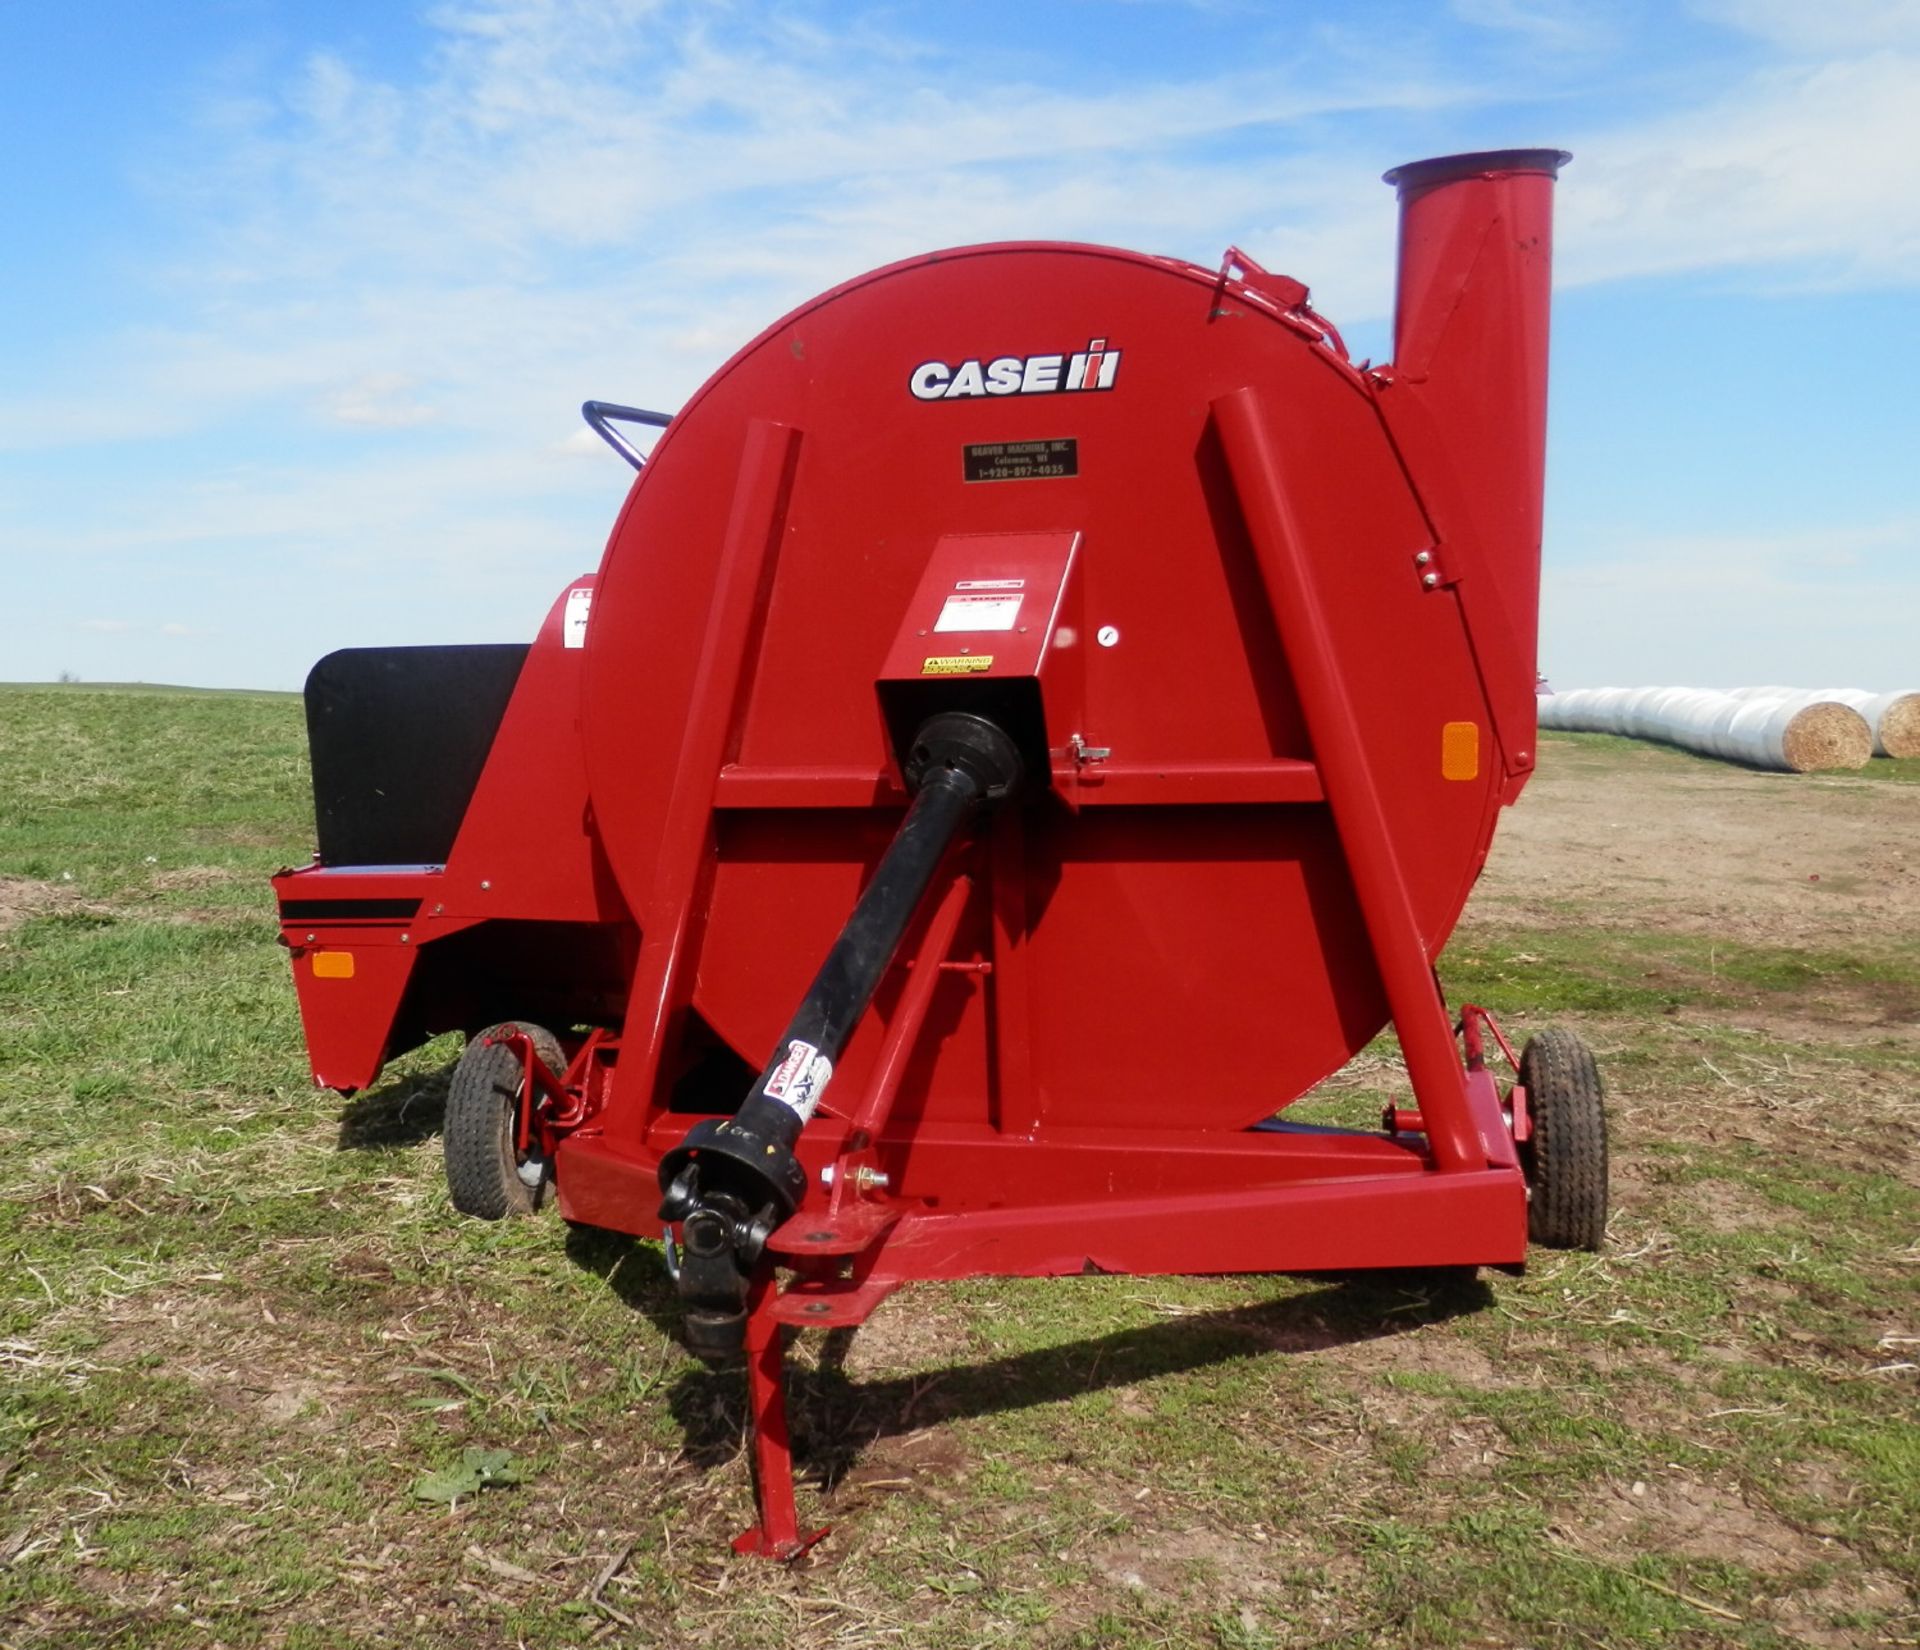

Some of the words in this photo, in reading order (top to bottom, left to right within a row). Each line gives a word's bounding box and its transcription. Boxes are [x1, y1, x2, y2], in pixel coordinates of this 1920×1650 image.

[910, 355, 1062, 399] CASE
[971, 446, 1003, 456] BEAVER
[979, 465, 1063, 478] 1-920-897-4035
[940, 657, 991, 666] WARNING
[778, 1044, 807, 1083] DANGER
